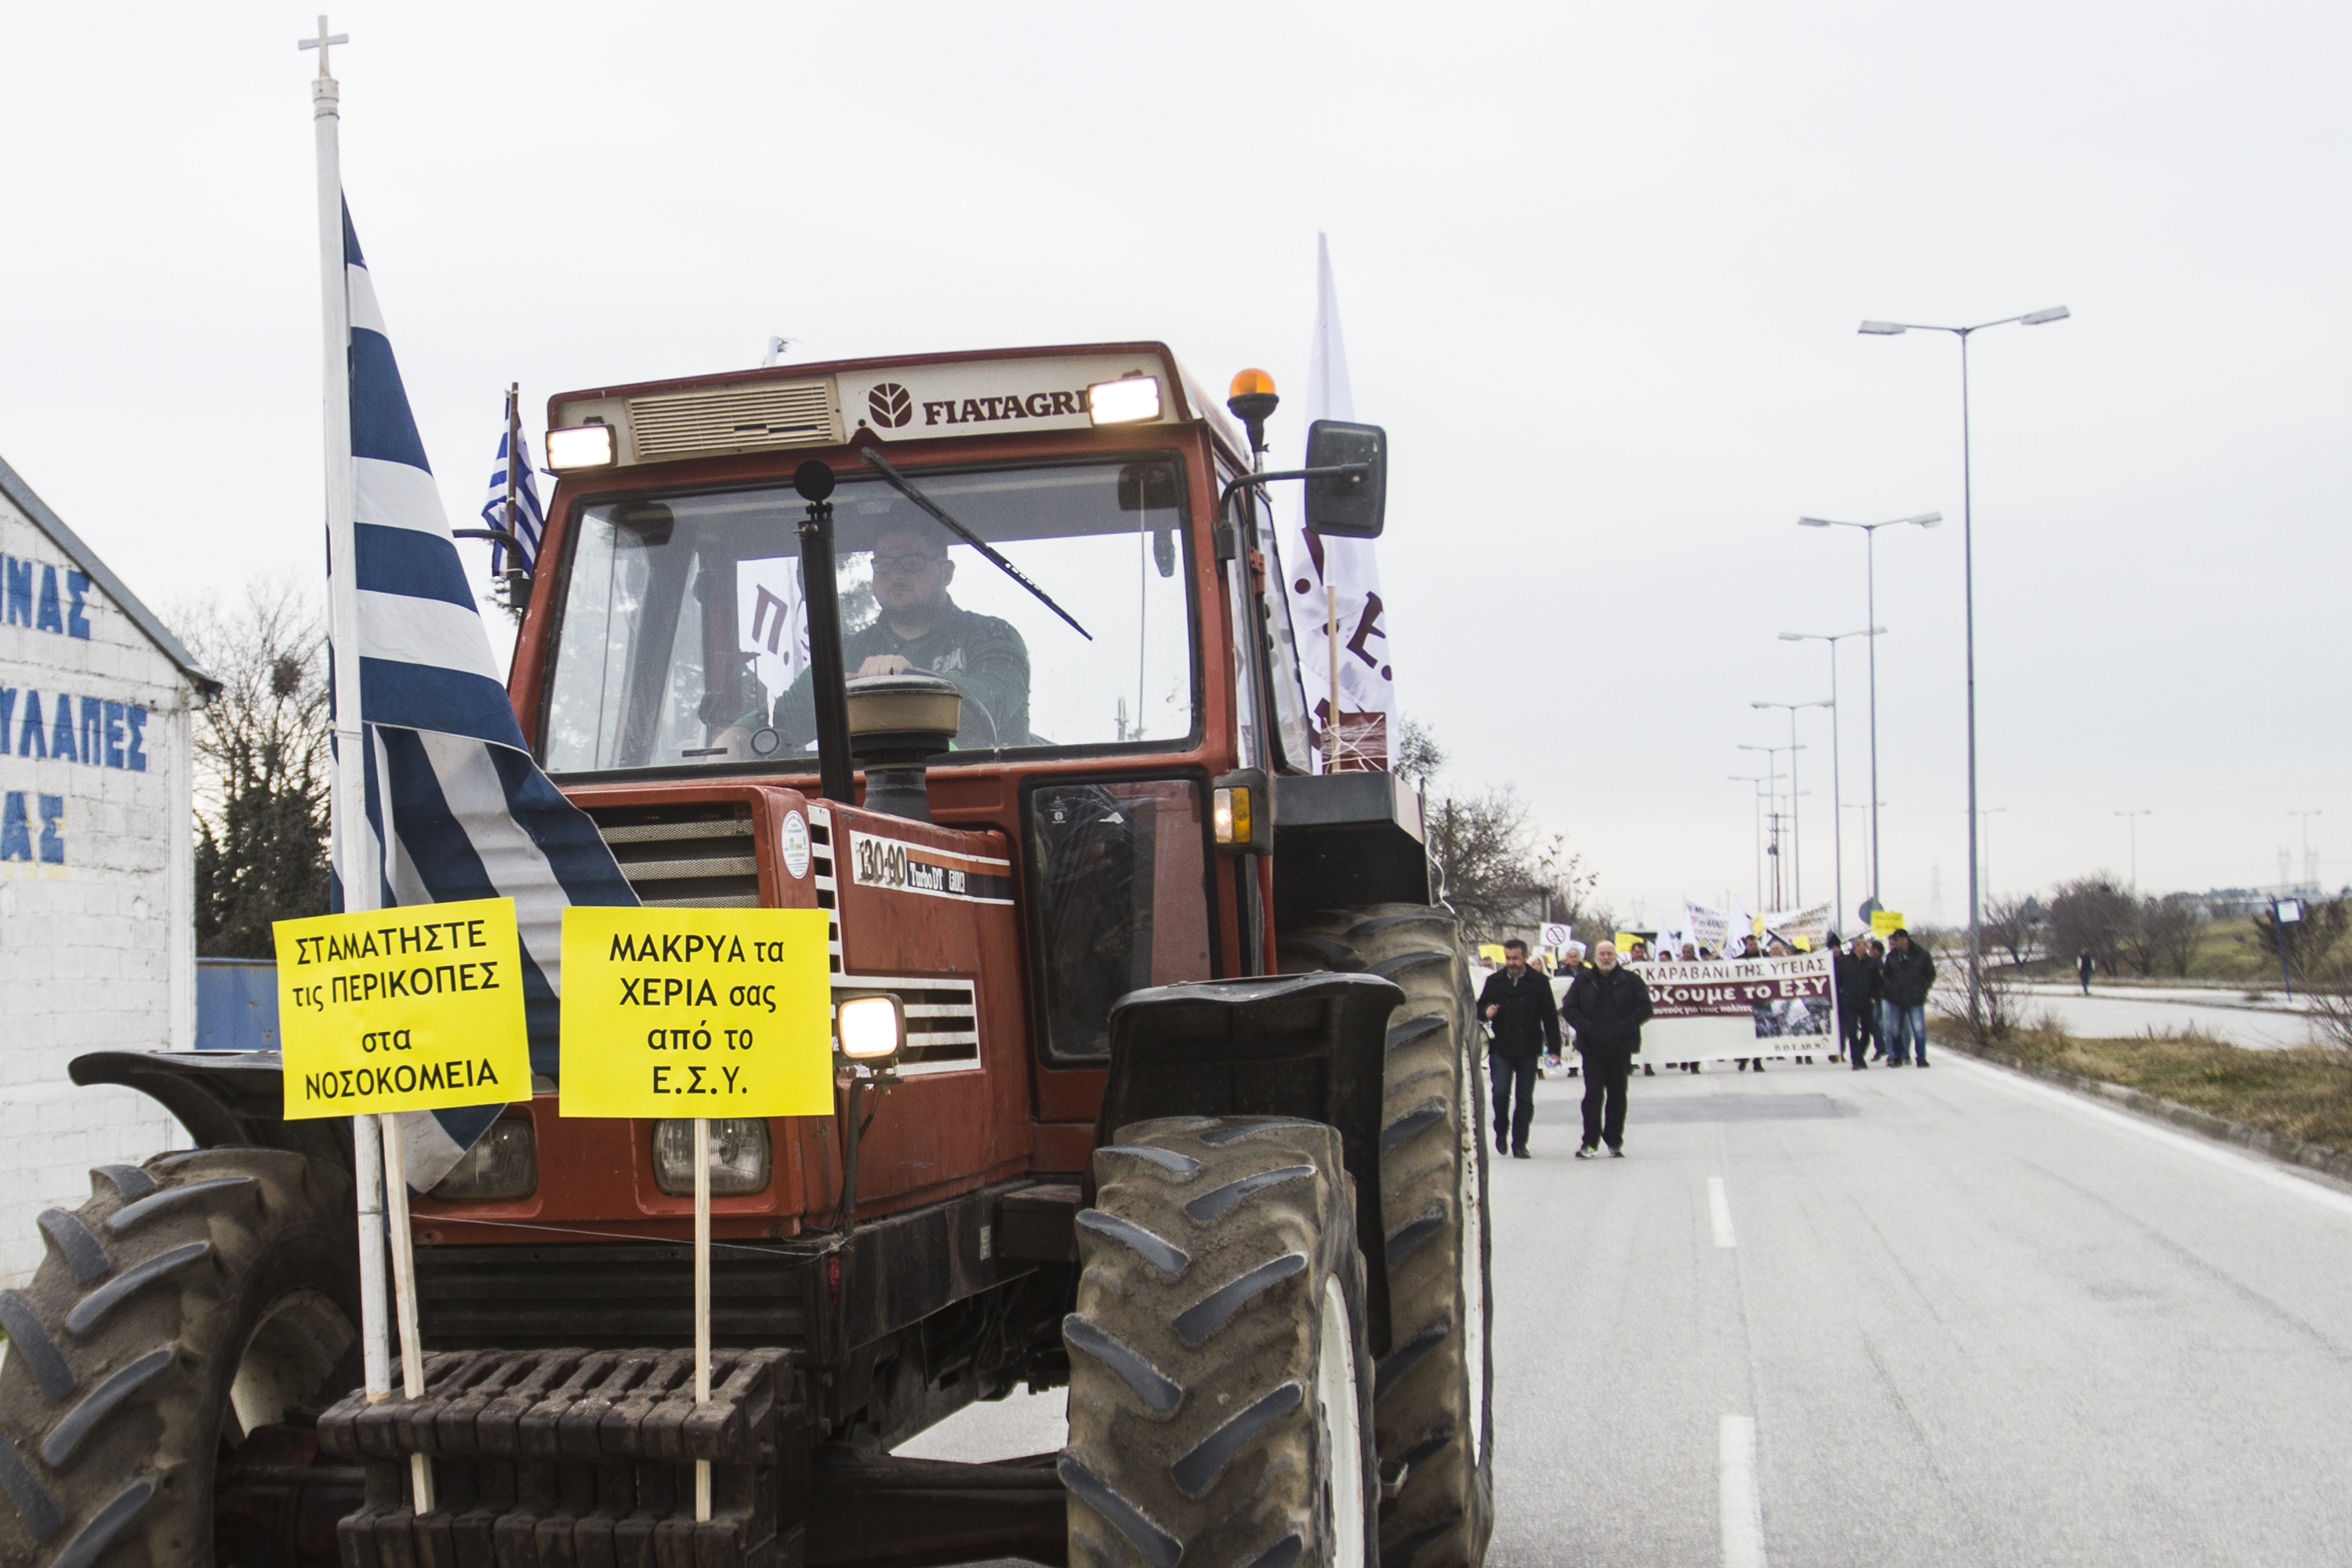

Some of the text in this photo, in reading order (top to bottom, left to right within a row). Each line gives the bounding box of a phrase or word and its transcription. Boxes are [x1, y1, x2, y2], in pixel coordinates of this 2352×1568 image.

[922, 390, 1091, 426] FIATAGRI
[0, 552, 91, 641] ΝΑΣ
[858, 839, 906, 887] 130-90
[296, 920, 487, 965] ΣΤΑΜΑΤΗΣΤΕ
[609, 933, 784, 963] ΜΑΚΡΥΑ τα
[292, 961, 499, 1012] τις ΠΕΡΙΚΟΠΕΣ
[1646, 966, 1730, 981] ΚΑΡΑΒΑΝΙ
[1734, 964, 1765, 978] ΤΗΣ
[1769, 958, 1827, 975] ΥΓΕΙΑΣ
[619, 978, 776, 1014] ΧΕΡΙΑ σας
[1743, 984, 1772, 1000] το
[1779, 976, 1828, 997] ΕΣΥ
[361, 1029, 412, 1053] στα
[648, 1019, 753, 1051] από το
[306, 1058, 499, 1101] ΝΟΣΟΚΟΜΕΙΑ
[653, 1065, 747, 1095] Ε.Σ.Υ.
